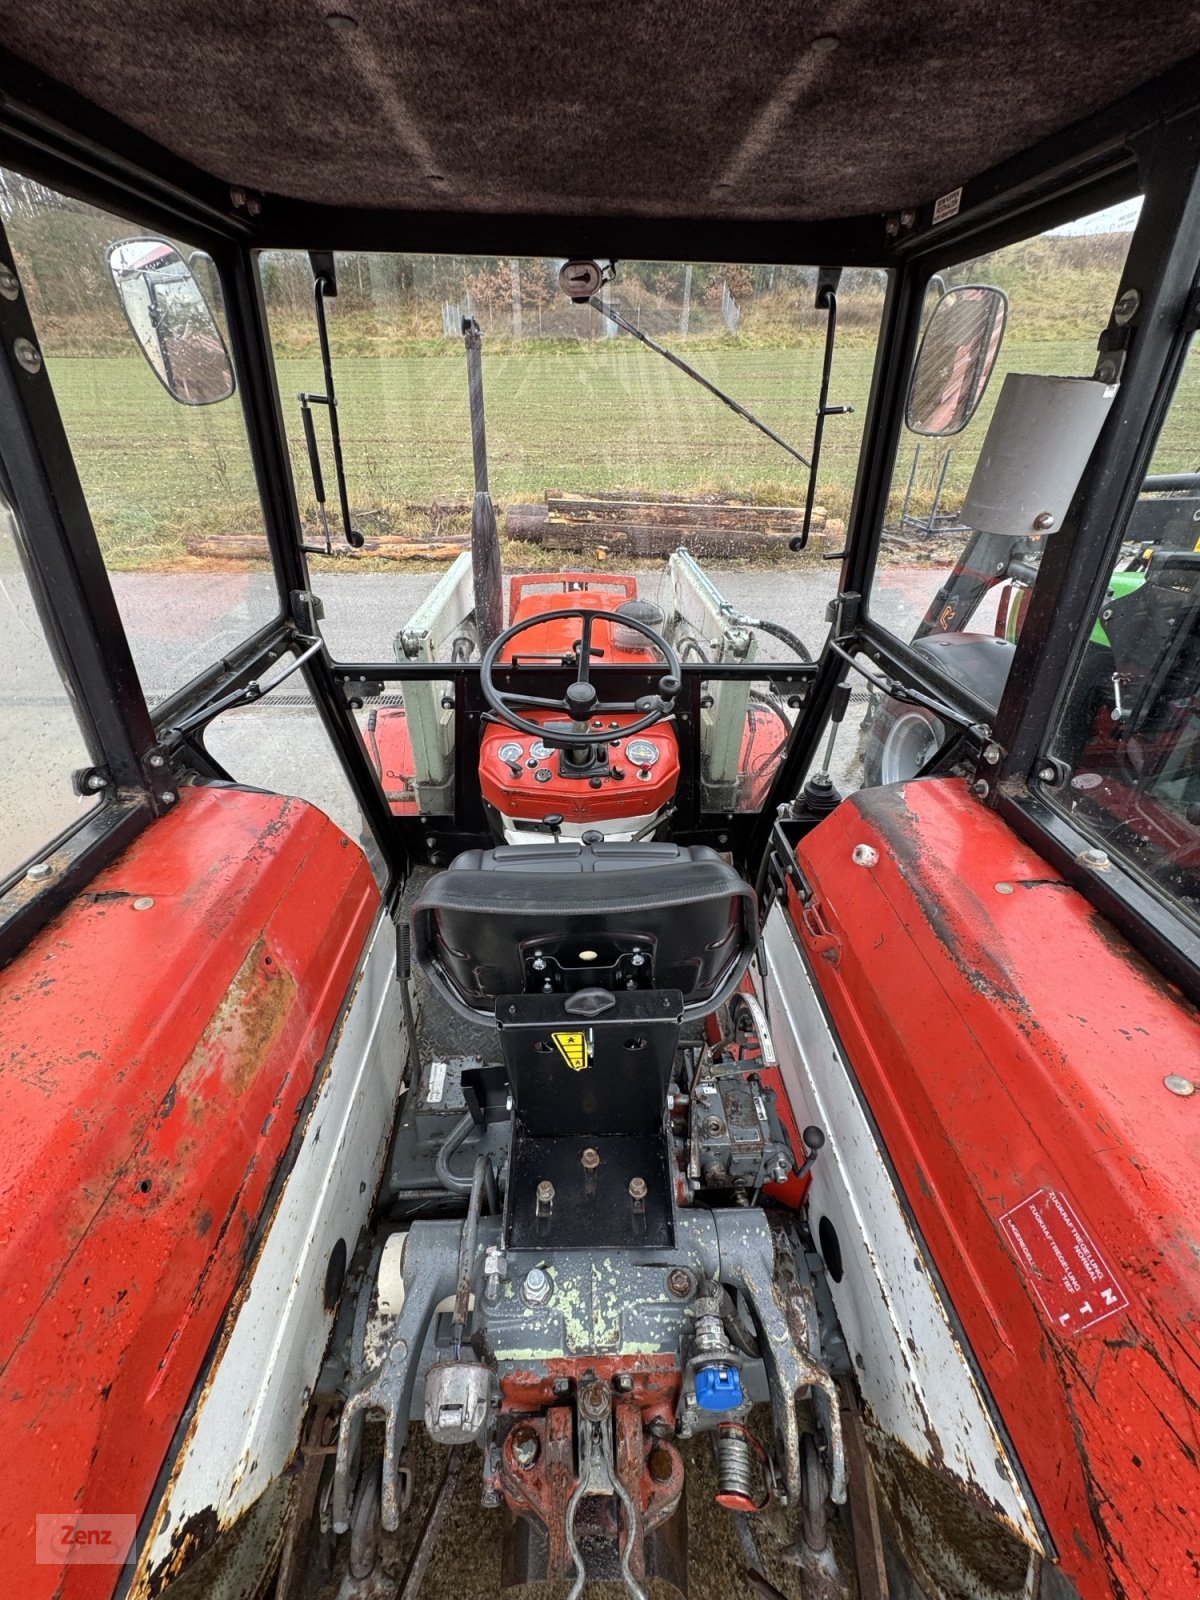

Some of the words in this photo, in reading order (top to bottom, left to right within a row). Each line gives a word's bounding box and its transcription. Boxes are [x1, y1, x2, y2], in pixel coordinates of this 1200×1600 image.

[1047, 1191, 1104, 1280] ZUGKRAFTREGELUNG
[1029, 1205, 1081, 1292] ZUGKRAFTREGELUNG
[1073, 1244, 1097, 1283] NORMAL
[1061, 1276, 1075, 1295] TIEF
[1101, 1288, 1117, 1305] N
[1079, 1301, 1093, 1315] T
[1058, 1313, 1071, 1327] L
